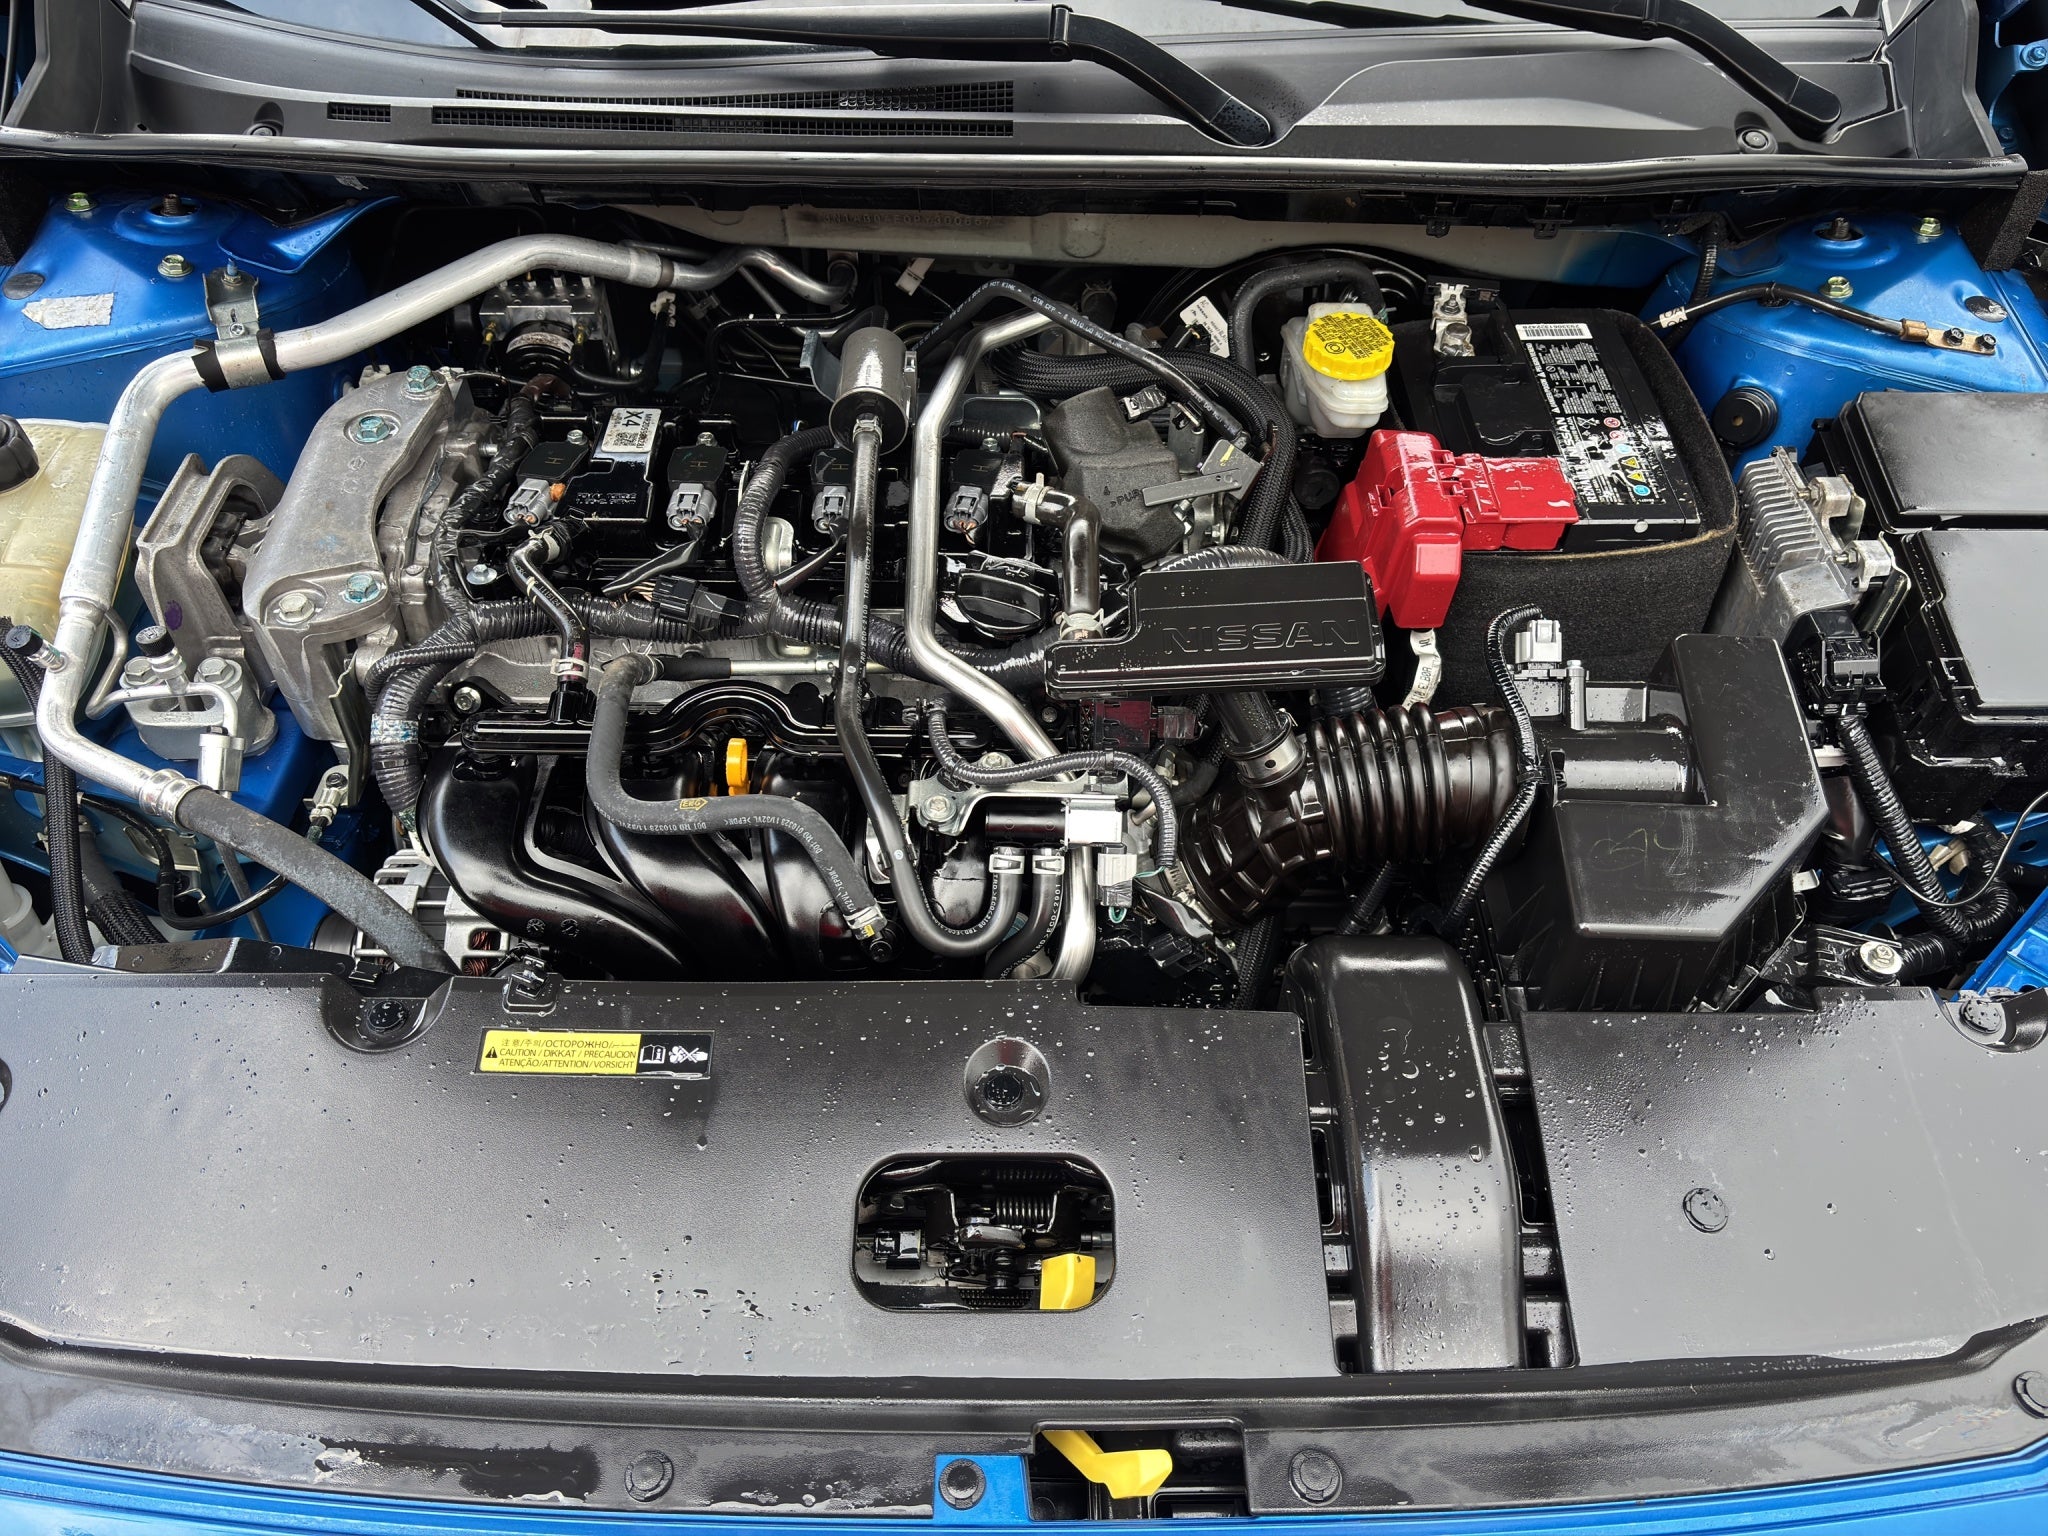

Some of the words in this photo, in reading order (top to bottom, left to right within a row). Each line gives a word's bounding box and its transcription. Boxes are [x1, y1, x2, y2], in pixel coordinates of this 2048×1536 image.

[1001, 281, 1016, 292] KINK
[622, 411, 644, 427] X4
[1554, 416, 1579, 457] NISSAN
[1162, 619, 1360, 655] NISSAN
[499, 1048, 536, 1057] CAUTION
[543, 1049, 576, 1058] DIKKAT
